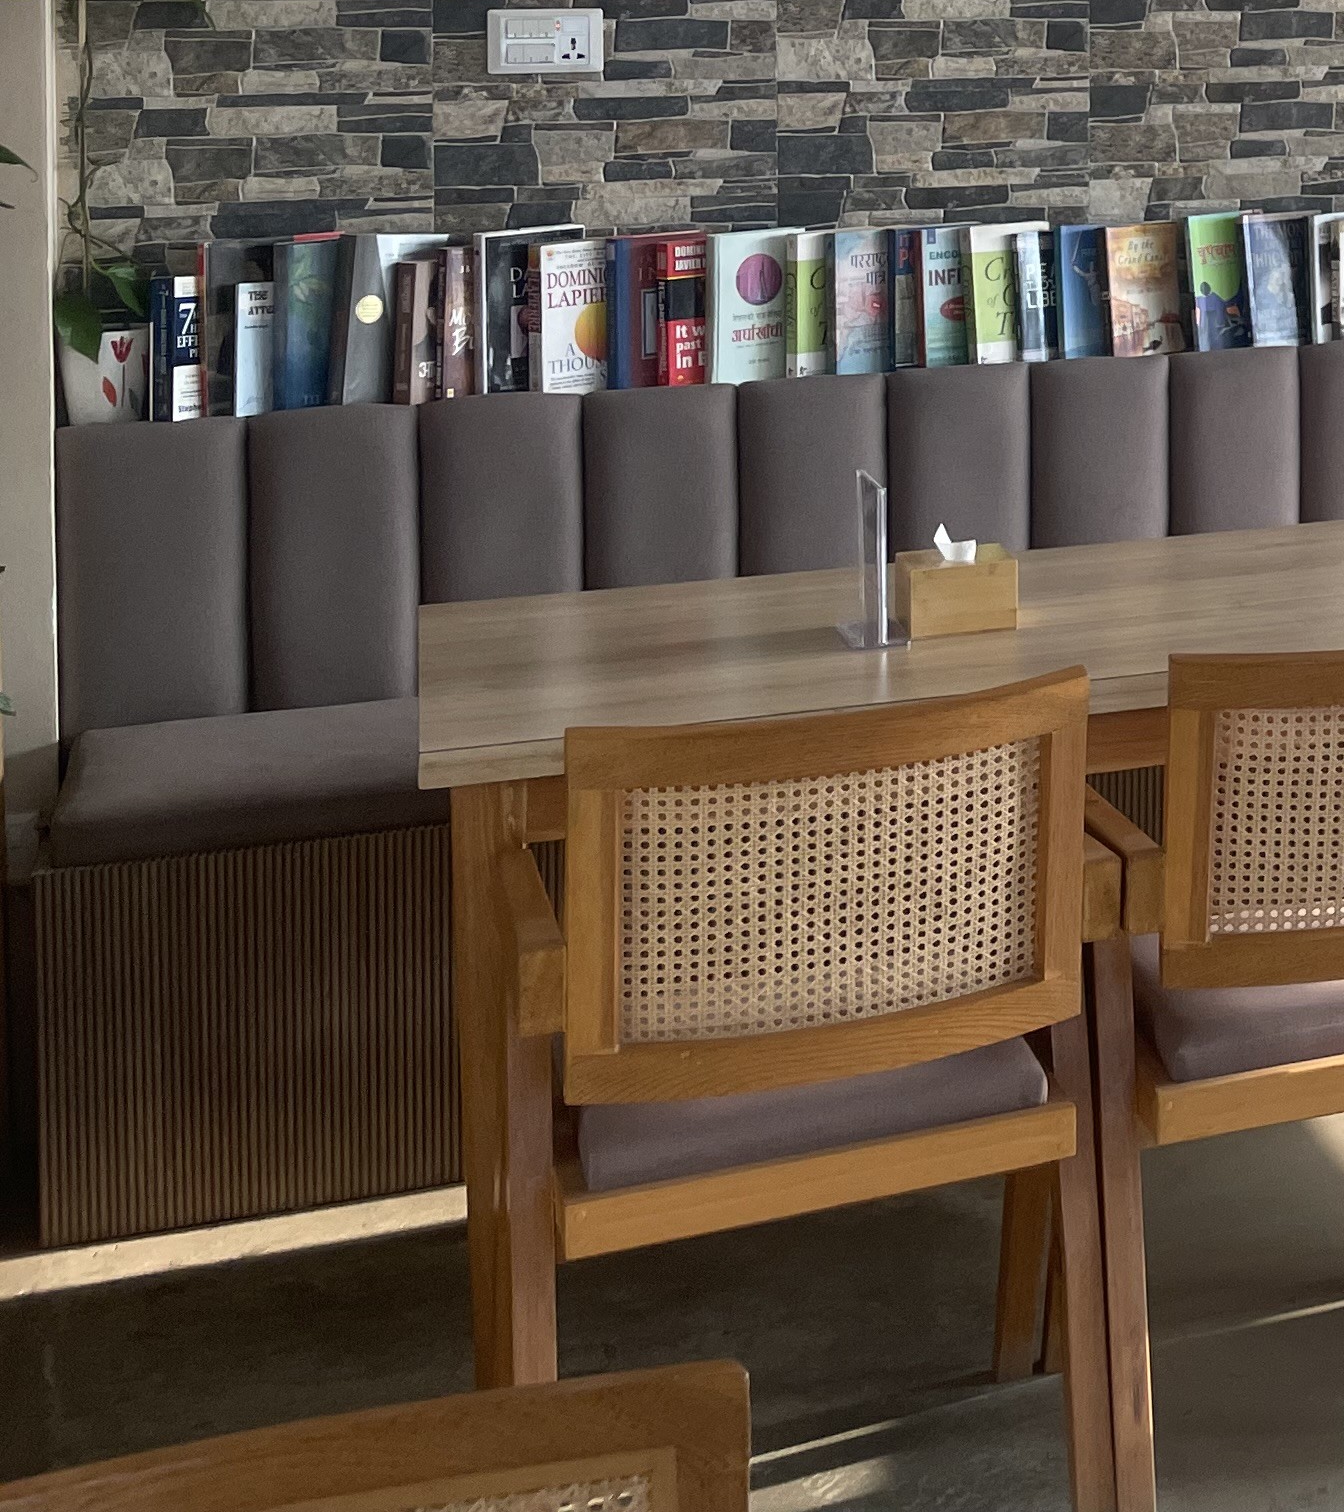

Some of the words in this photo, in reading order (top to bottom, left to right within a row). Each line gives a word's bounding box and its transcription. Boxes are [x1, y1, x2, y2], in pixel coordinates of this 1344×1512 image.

[178, 303, 197, 336] 7
[675, 324, 688, 339] It
[676, 340, 702, 354] past
